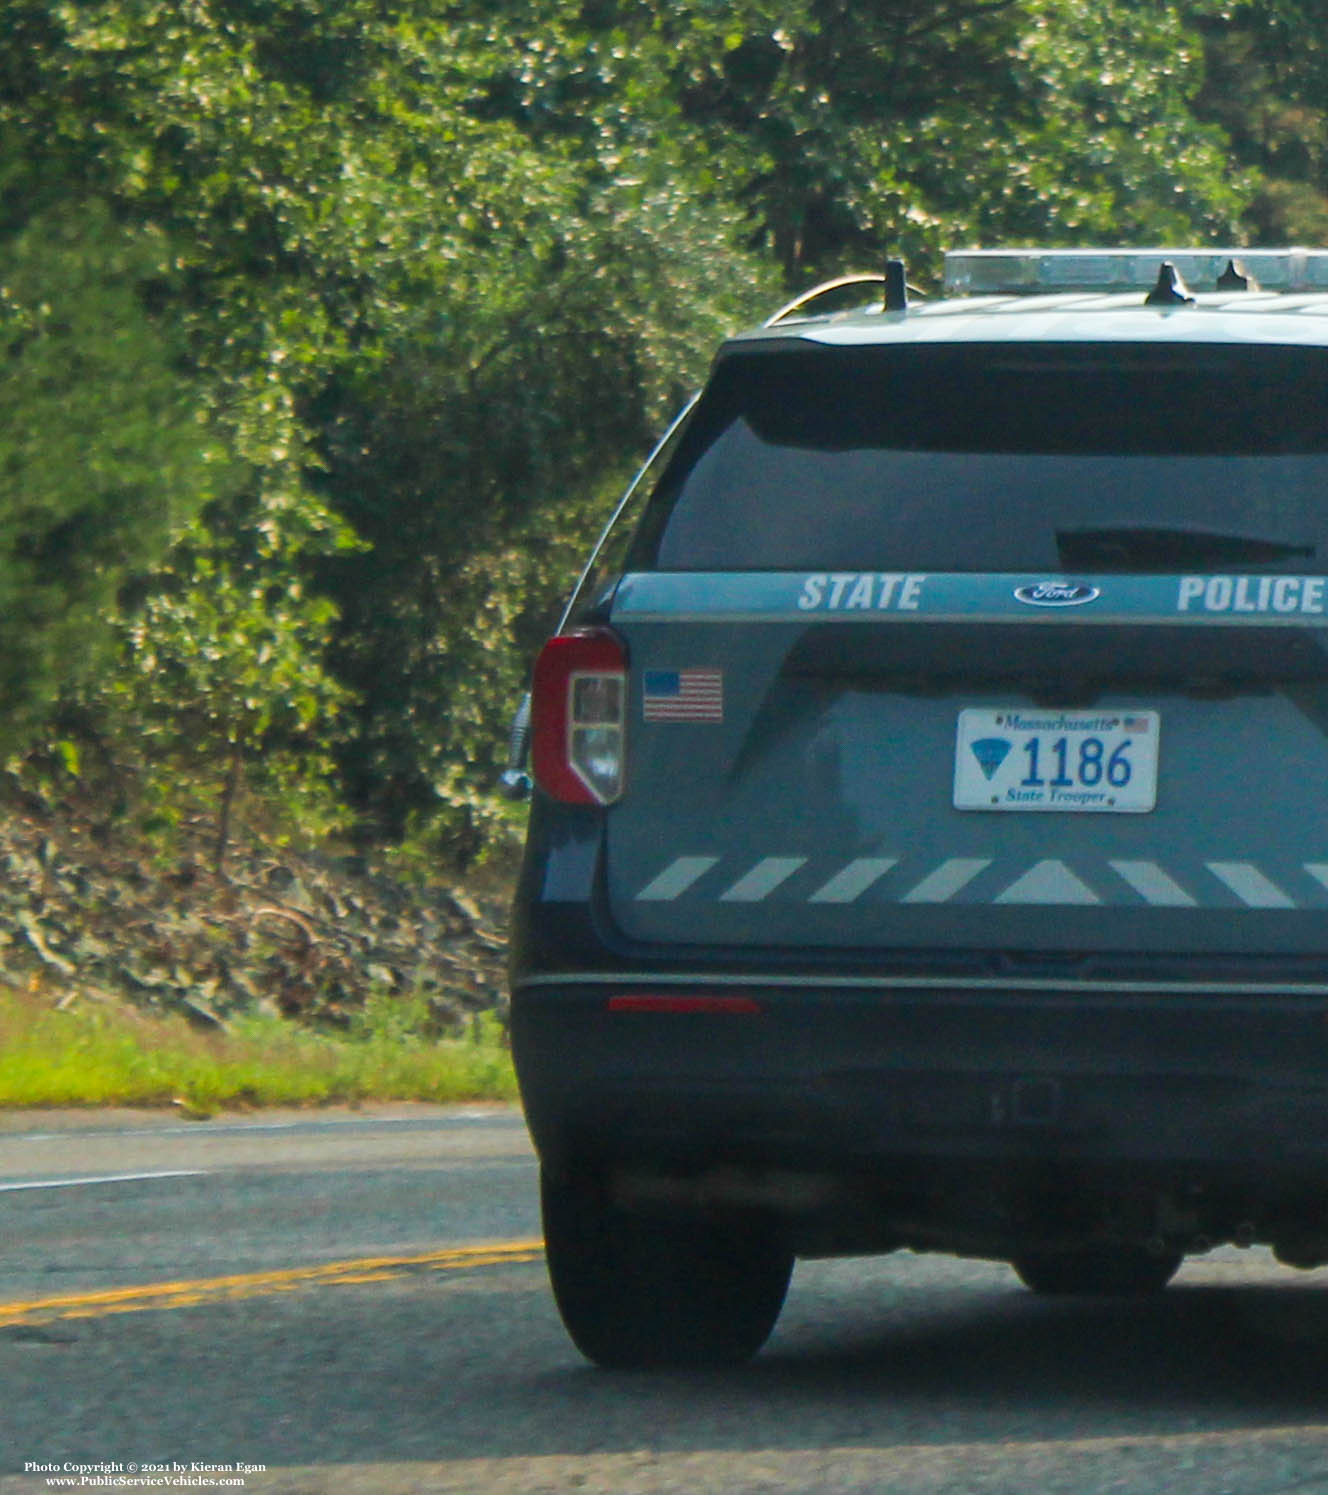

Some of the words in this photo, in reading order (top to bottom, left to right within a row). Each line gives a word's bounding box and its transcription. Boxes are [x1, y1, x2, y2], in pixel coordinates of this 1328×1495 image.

[798, 575, 926, 610] STATE
[1029, 582, 1080, 600] Ford
[1177, 577, 1325, 612] POLICE
[1004, 714, 1114, 731] Massachusetts
[1021, 737, 1132, 788] 1186
[1005, 787, 1044, 802] State
[1049, 788, 1107, 804] Trooper
